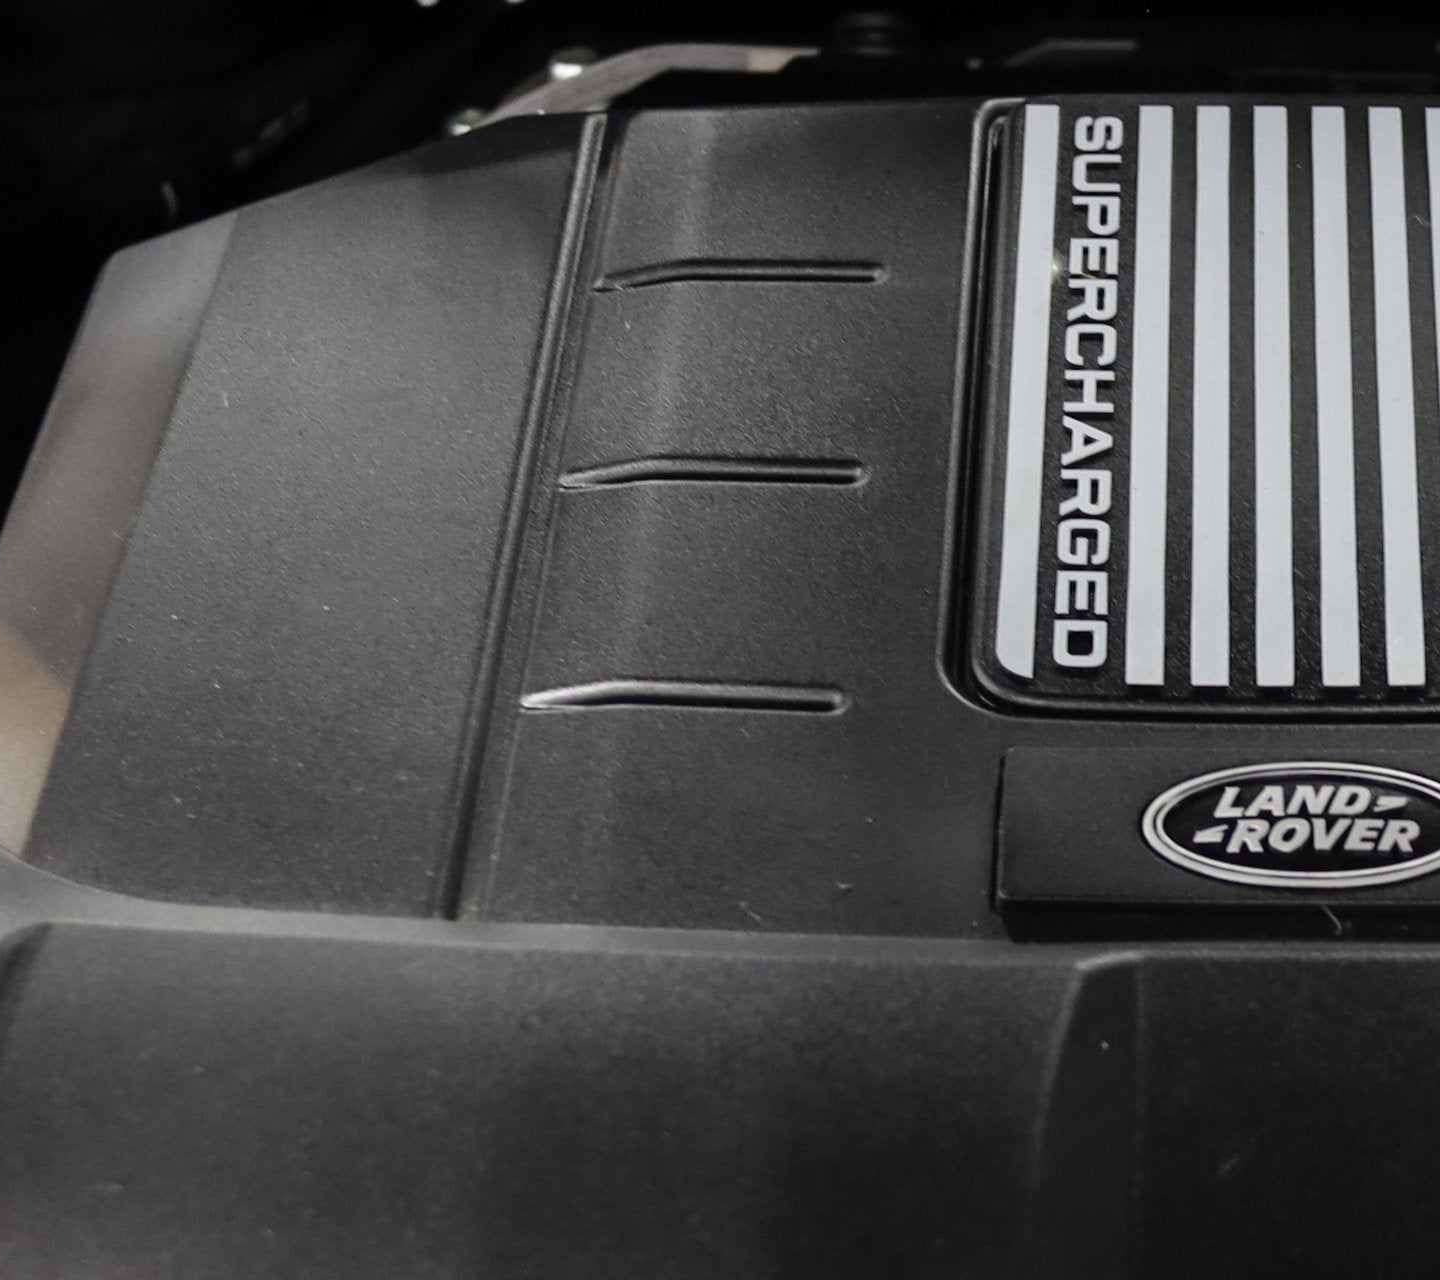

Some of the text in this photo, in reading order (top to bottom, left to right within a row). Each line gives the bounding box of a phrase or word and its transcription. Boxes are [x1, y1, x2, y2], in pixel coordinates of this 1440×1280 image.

[1052, 114, 1124, 669] SUPERCHARGED
[1213, 784, 1372, 819] LAND
[1225, 817, 1421, 855] ROVER
